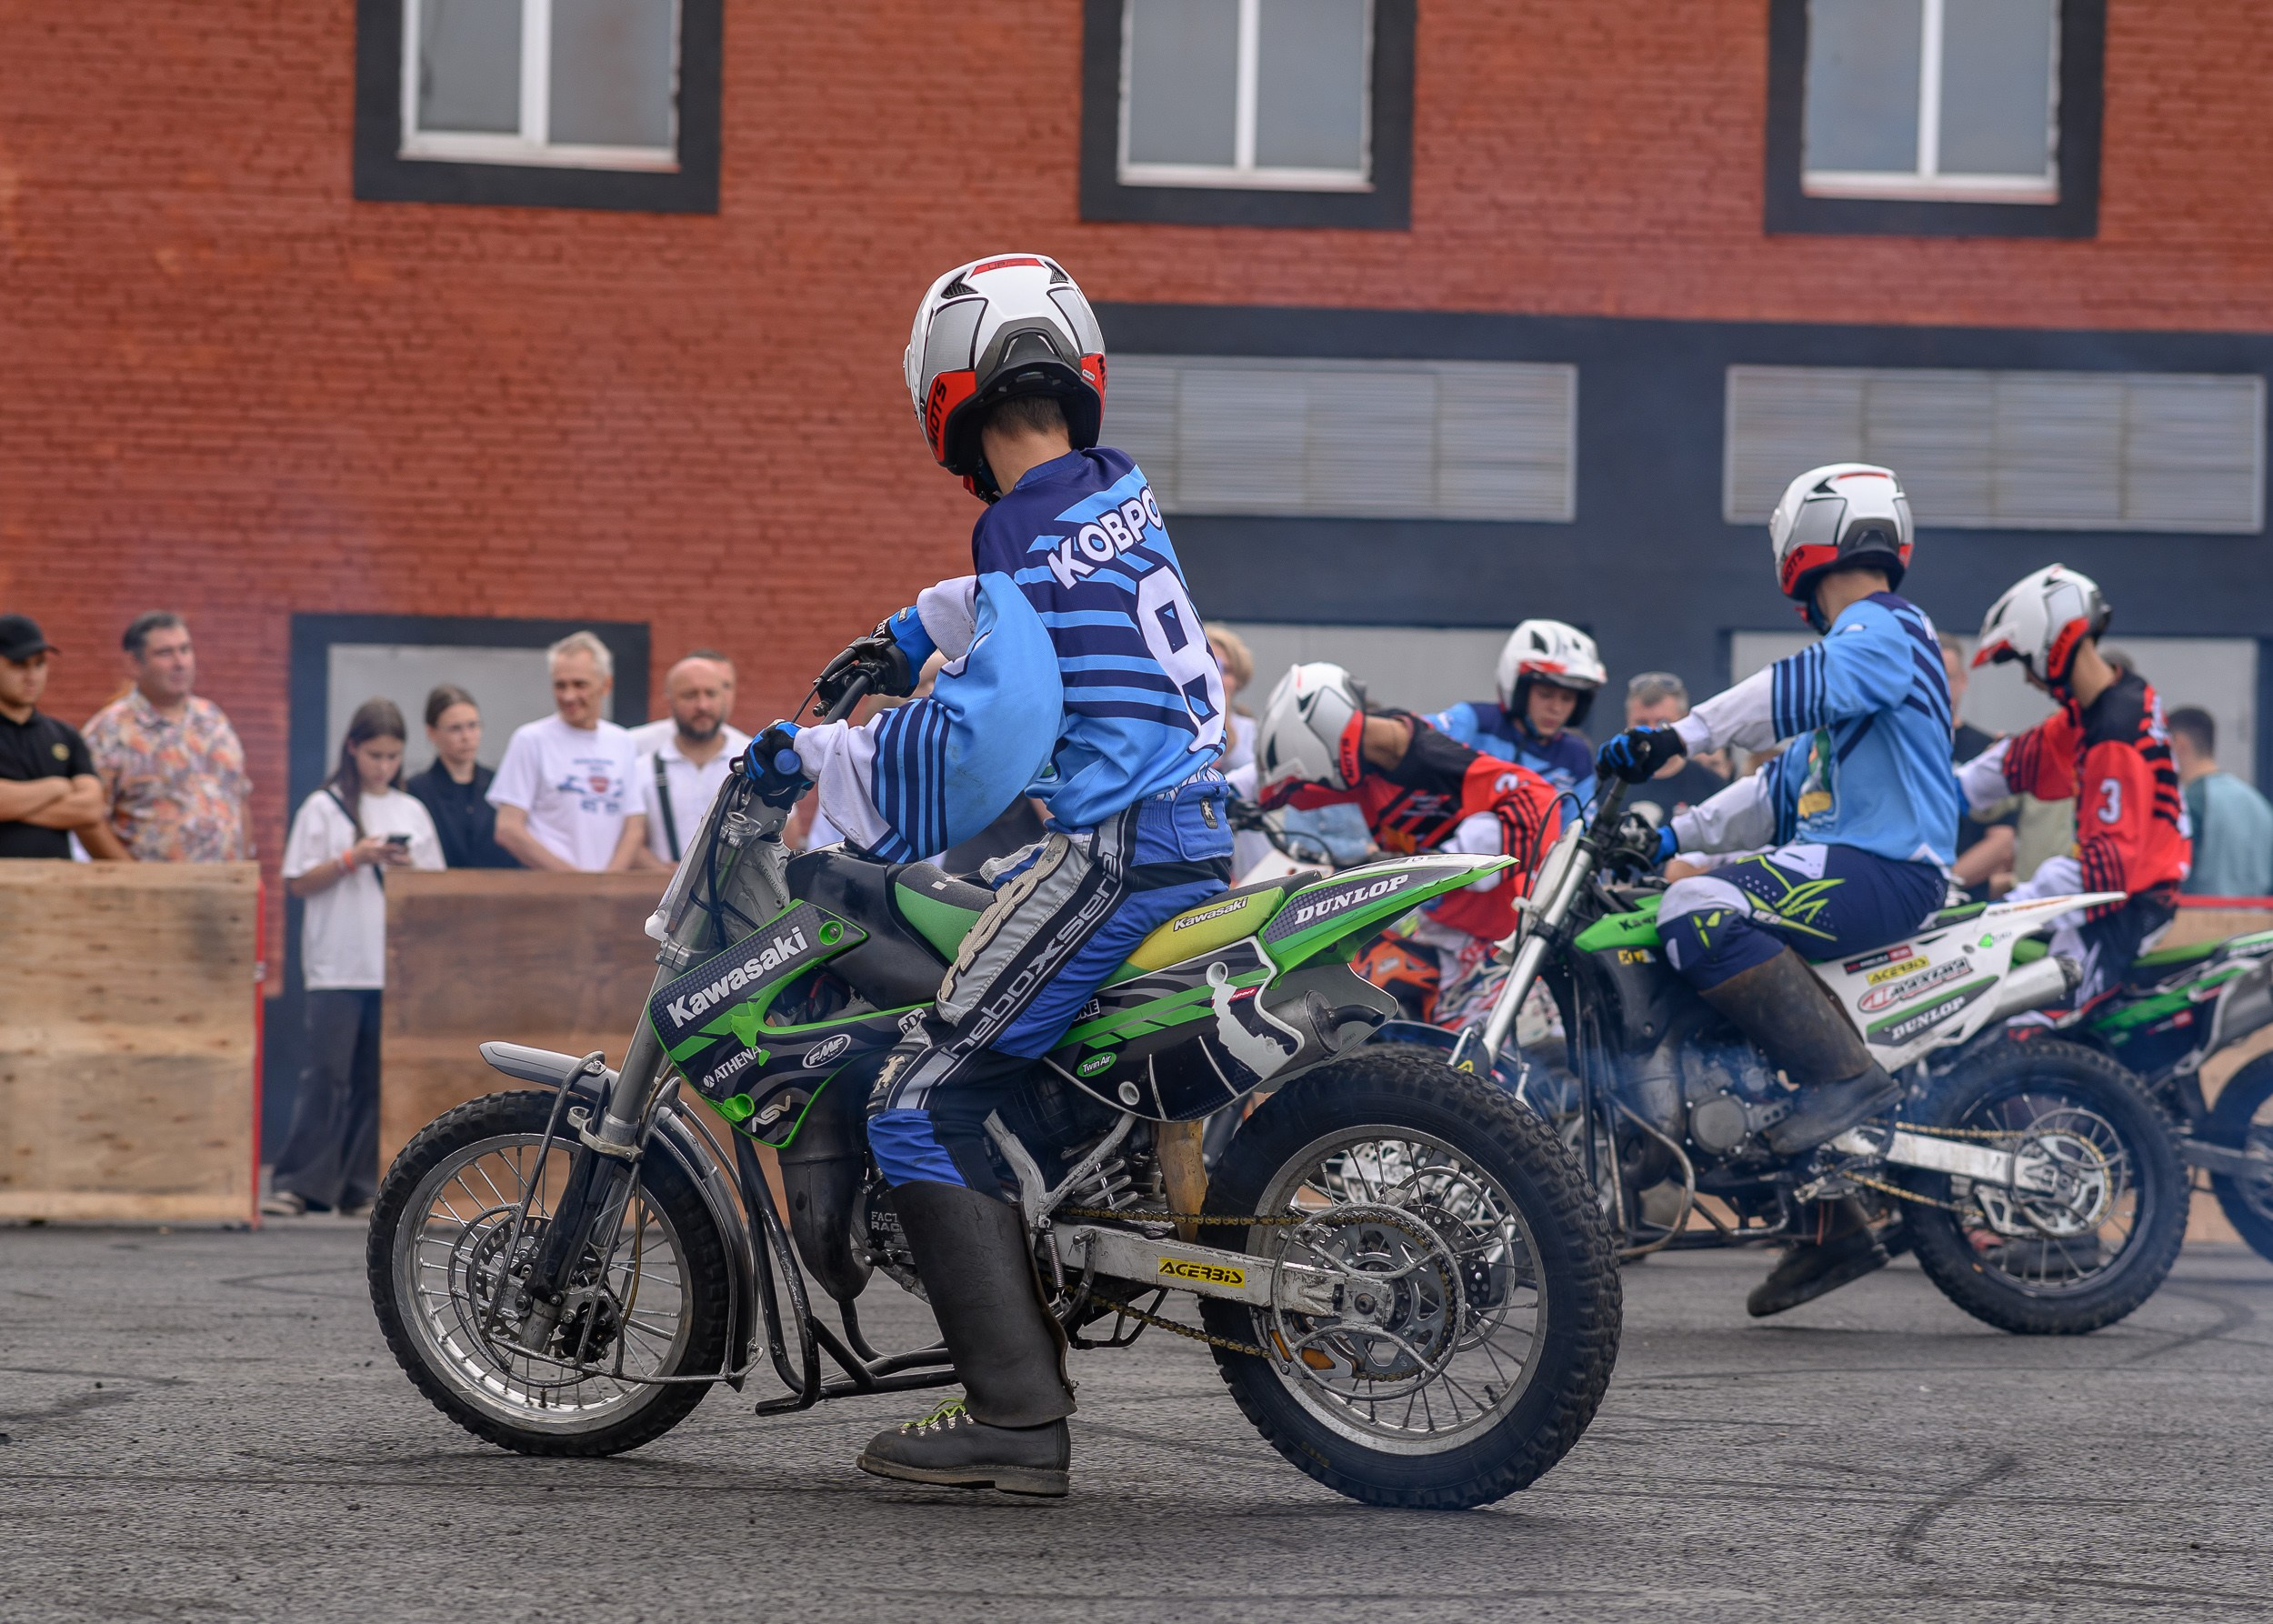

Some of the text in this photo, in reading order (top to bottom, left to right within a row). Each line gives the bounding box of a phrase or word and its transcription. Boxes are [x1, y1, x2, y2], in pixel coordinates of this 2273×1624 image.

[927, 377, 947, 452] MOTS
[1136, 566, 1226, 752] 8
[2098, 777, 2122, 825] 3
[1173, 897, 1248, 931] Kawasaki
[1295, 874, 1408, 926] DUNLOP
[666, 926, 808, 1028] Kawasaki
[1892, 996, 1965, 1040] DUNLOP
[715, 1046, 762, 1083] ATHENA
[809, 1037, 844, 1066] FMF
[1082, 1054, 1112, 1073] Twin Air
[752, 1095, 791, 1133] ASV
